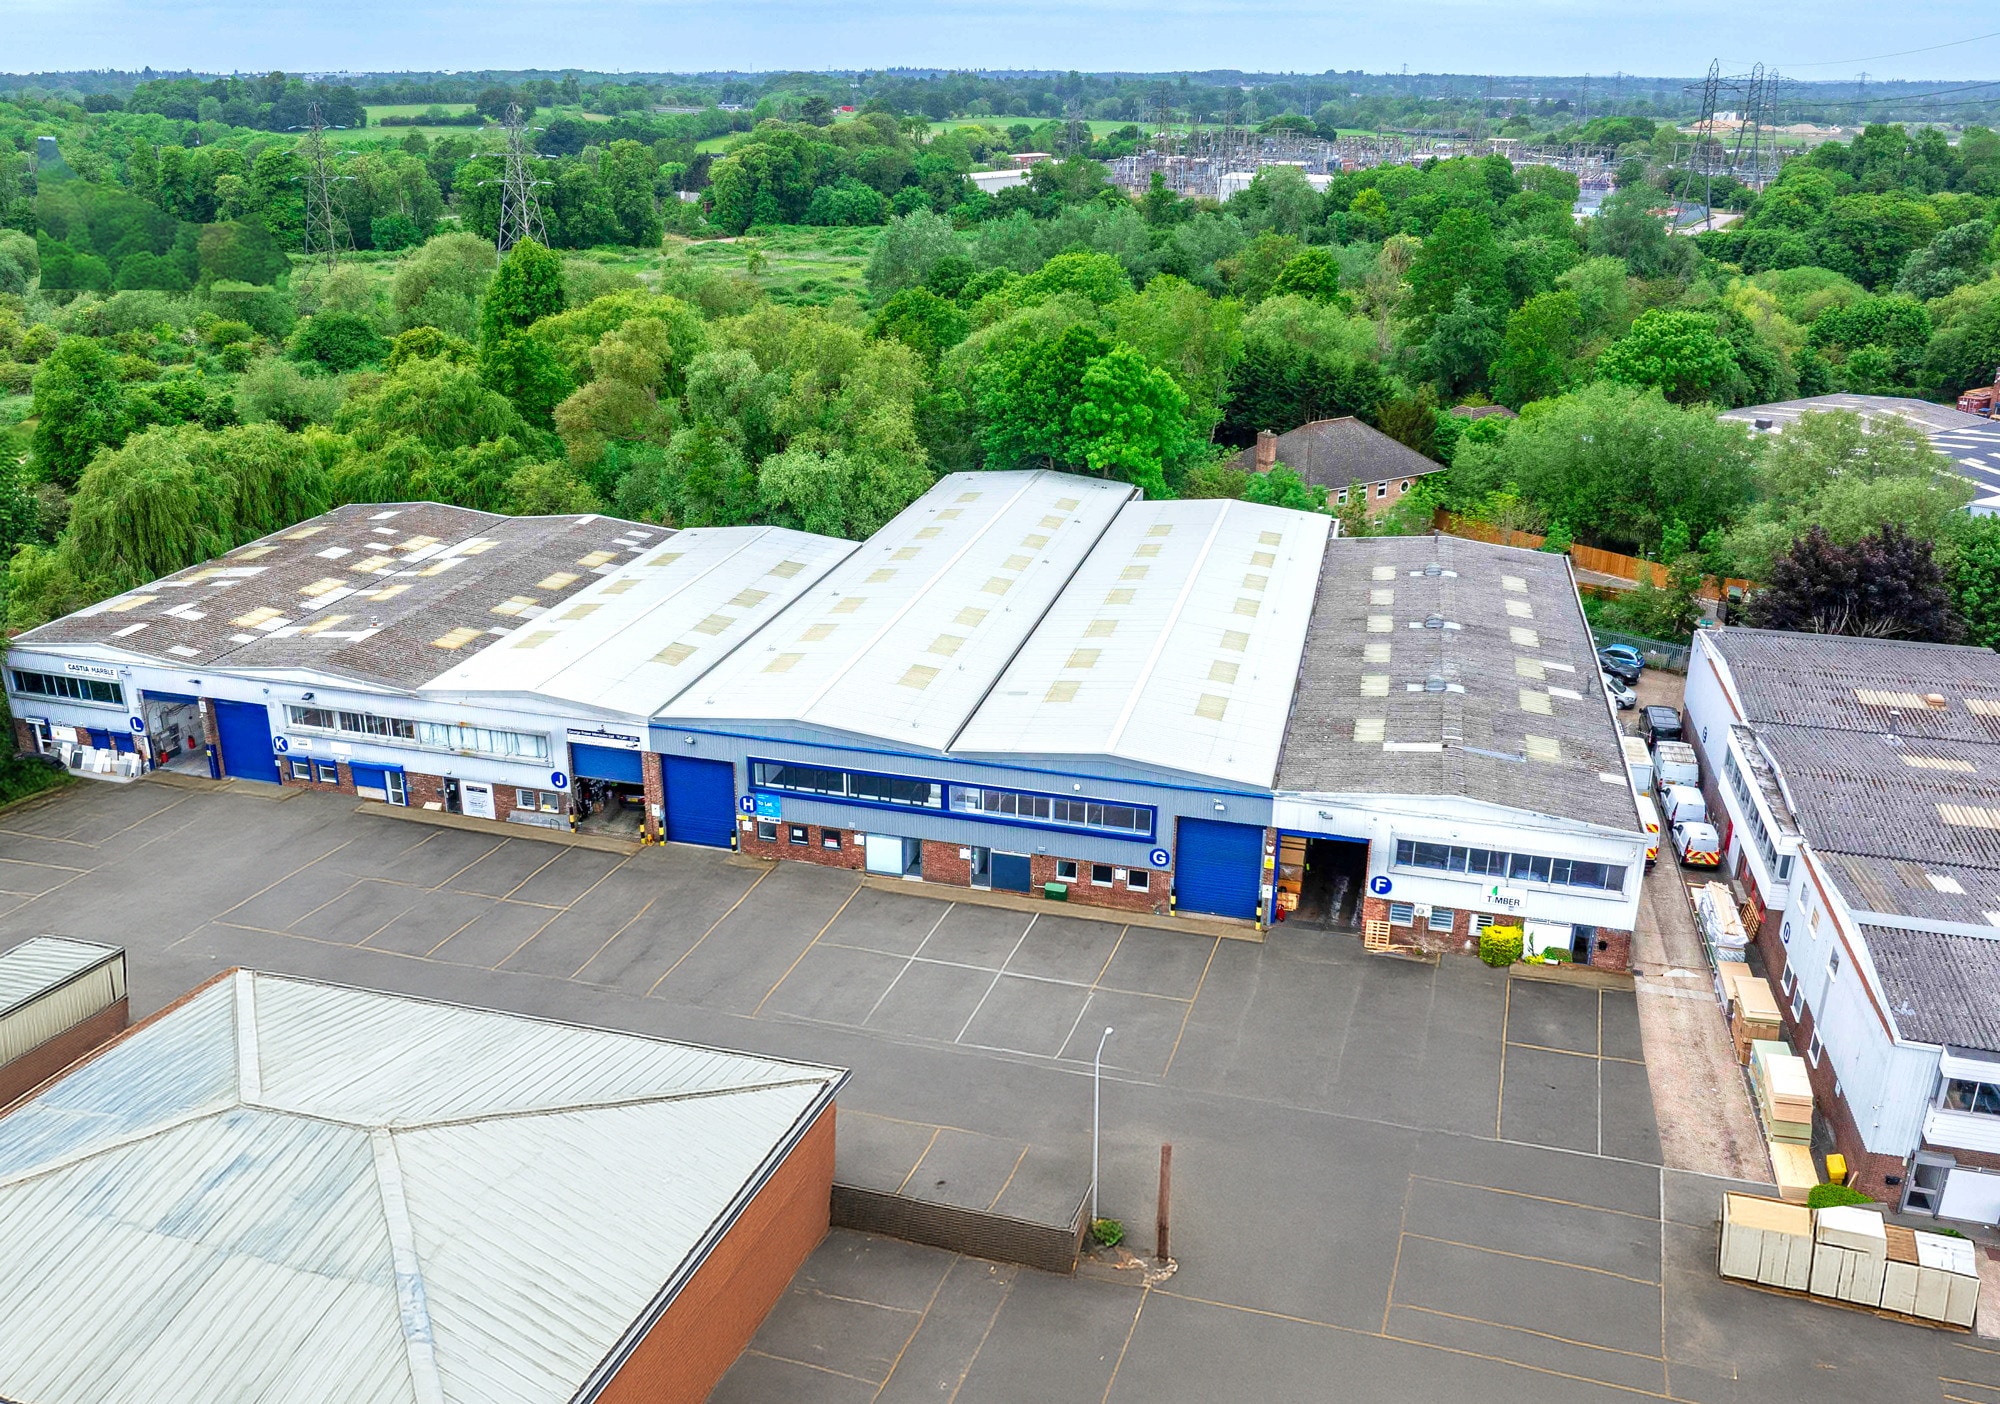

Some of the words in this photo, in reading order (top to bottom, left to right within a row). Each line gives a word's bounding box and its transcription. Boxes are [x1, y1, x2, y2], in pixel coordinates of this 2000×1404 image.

[67, 664, 90, 673] CASTIA
[91, 667, 114, 676] MARBLE
[132, 718, 142, 731] L
[275, 738, 286, 751] K
[555, 774, 564, 786] J
[742, 797, 754, 811] H
[1152, 850, 1167, 865] G
[1375, 878, 1388, 892] F
